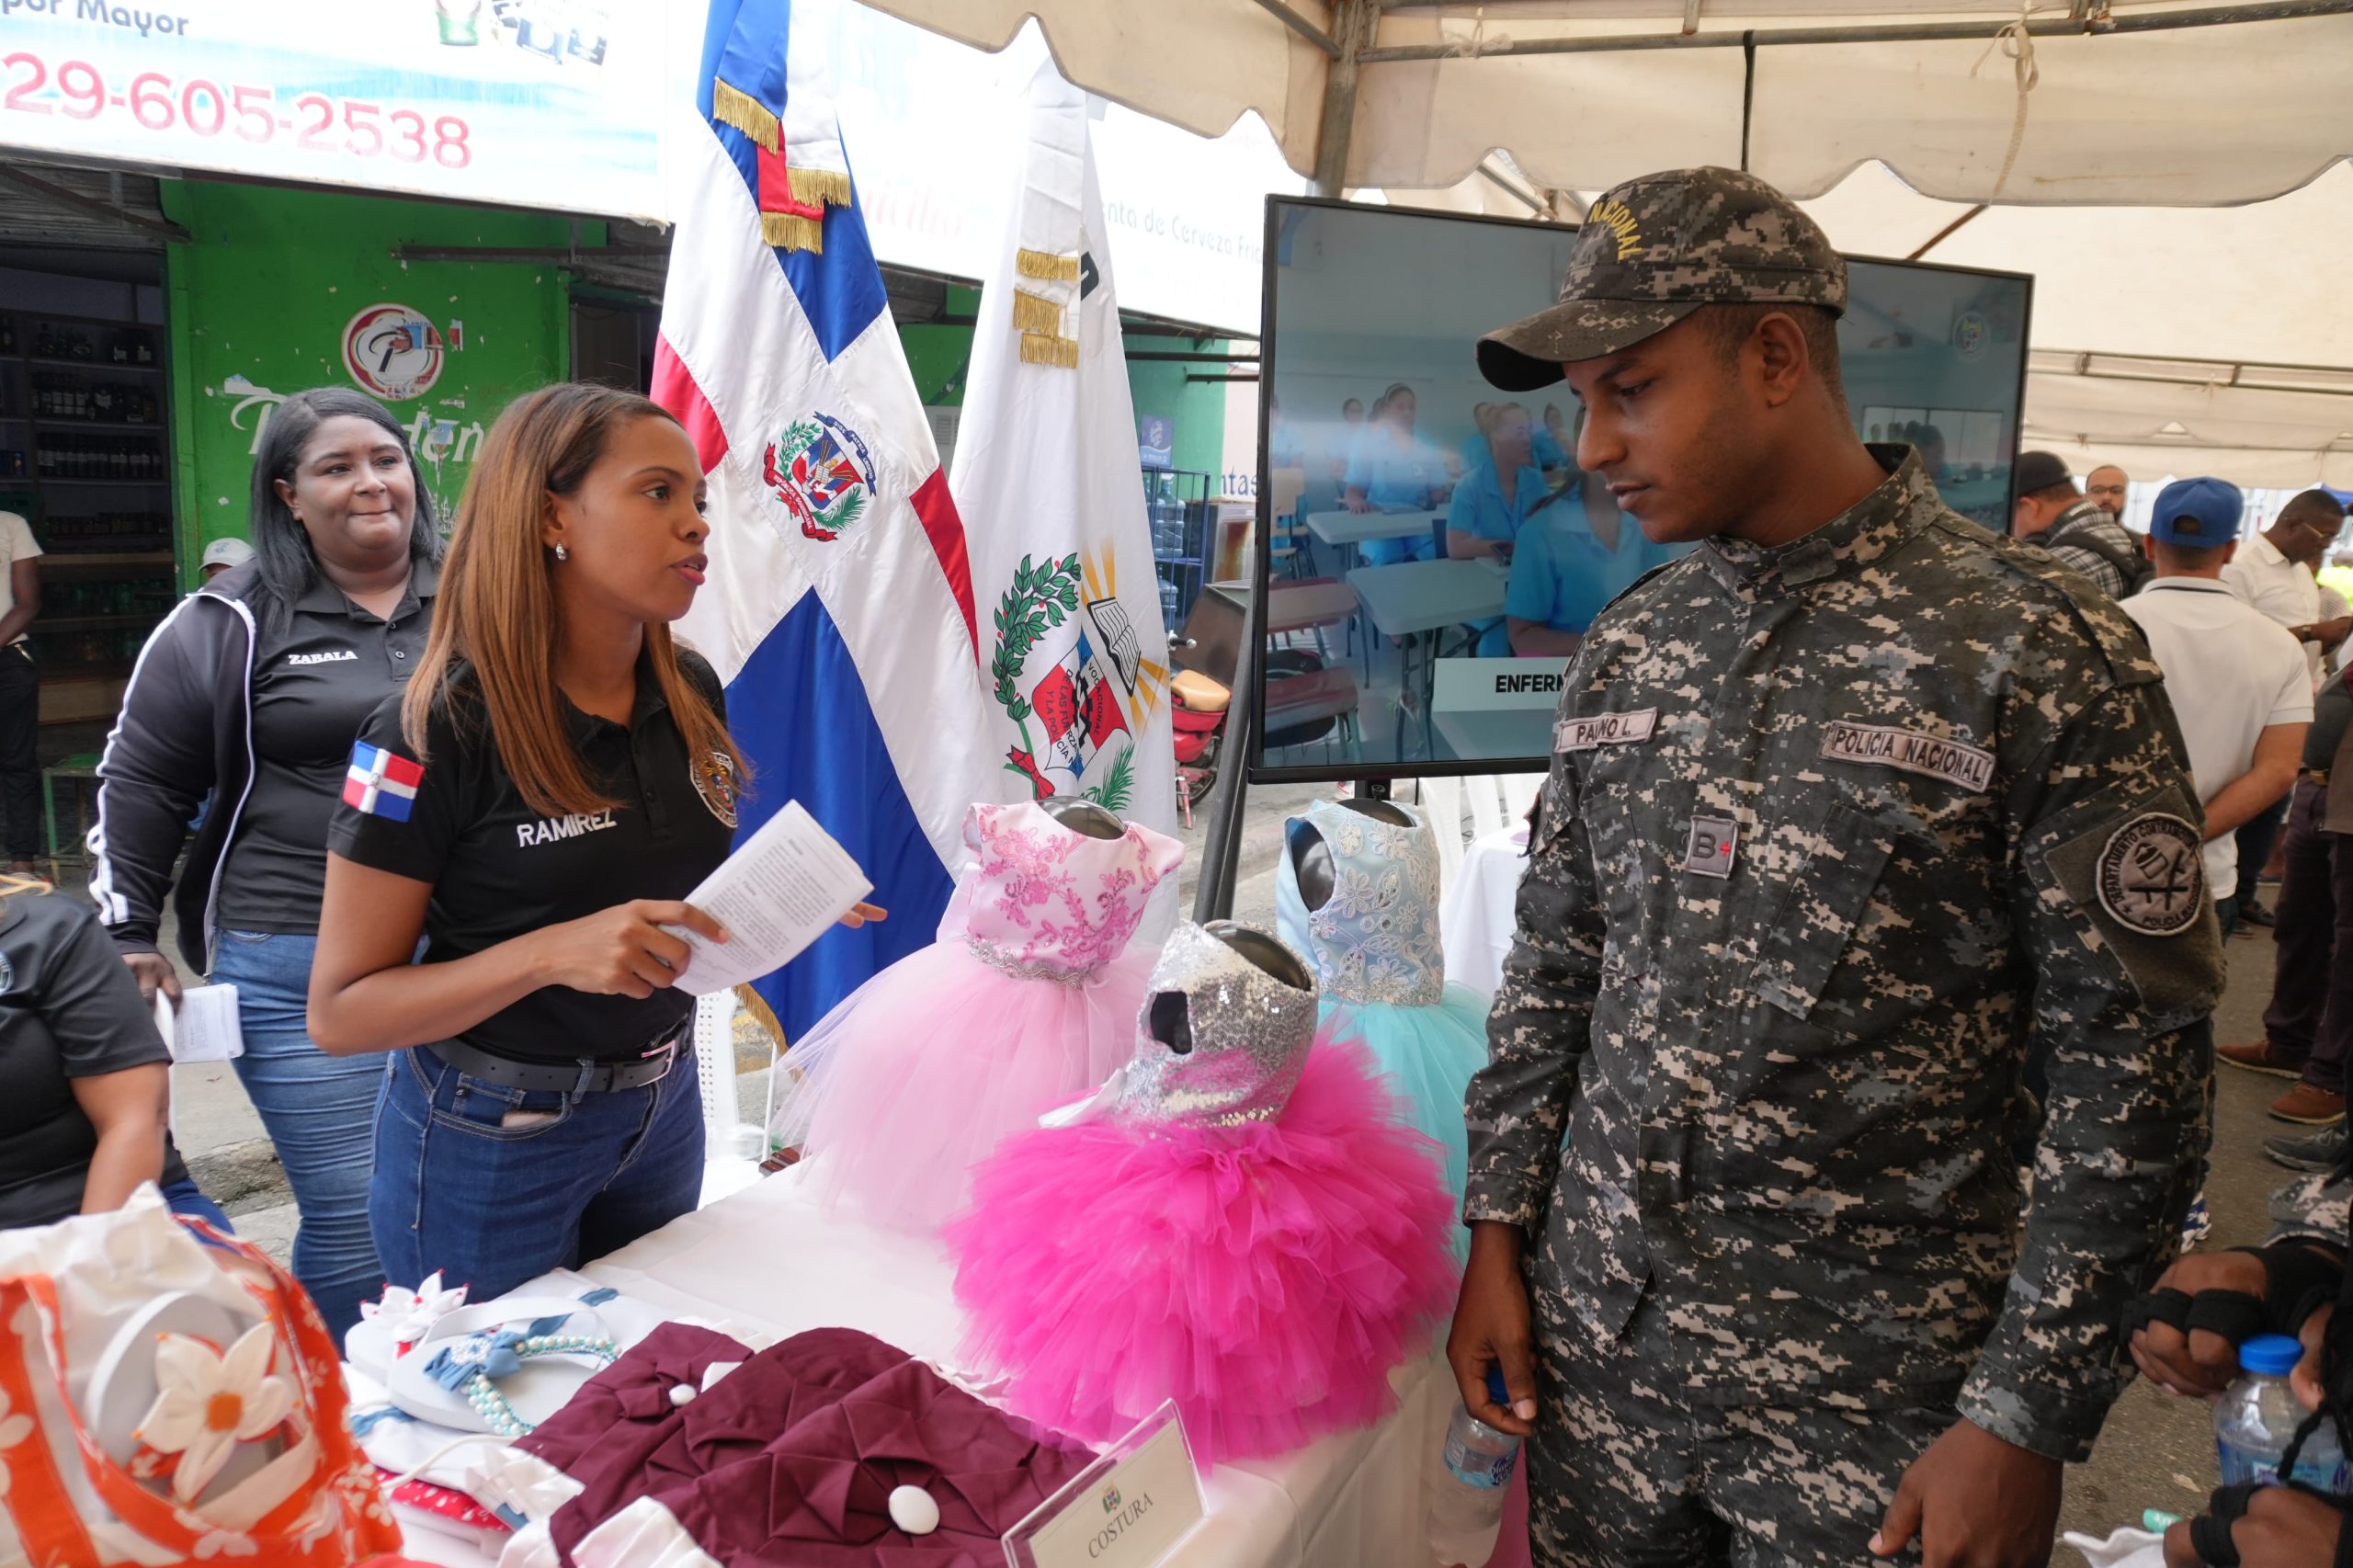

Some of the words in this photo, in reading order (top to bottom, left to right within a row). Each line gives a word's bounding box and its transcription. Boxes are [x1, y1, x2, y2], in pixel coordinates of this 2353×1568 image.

[2, 0, 63, 15] por
[76, 0, 189, 38] Mayor
[0, 51, 472, 169] 29-605-2538
[1144, 208, 1165, 236] de
[1171, 215, 1233, 256] Cerveza
[288, 650, 358, 665] ZABALA
[1907, 738, 1983, 783] NACIONAL
[517, 807, 618, 847] RAMIREZ
[1088, 1492, 1154, 1559] COSTURA
